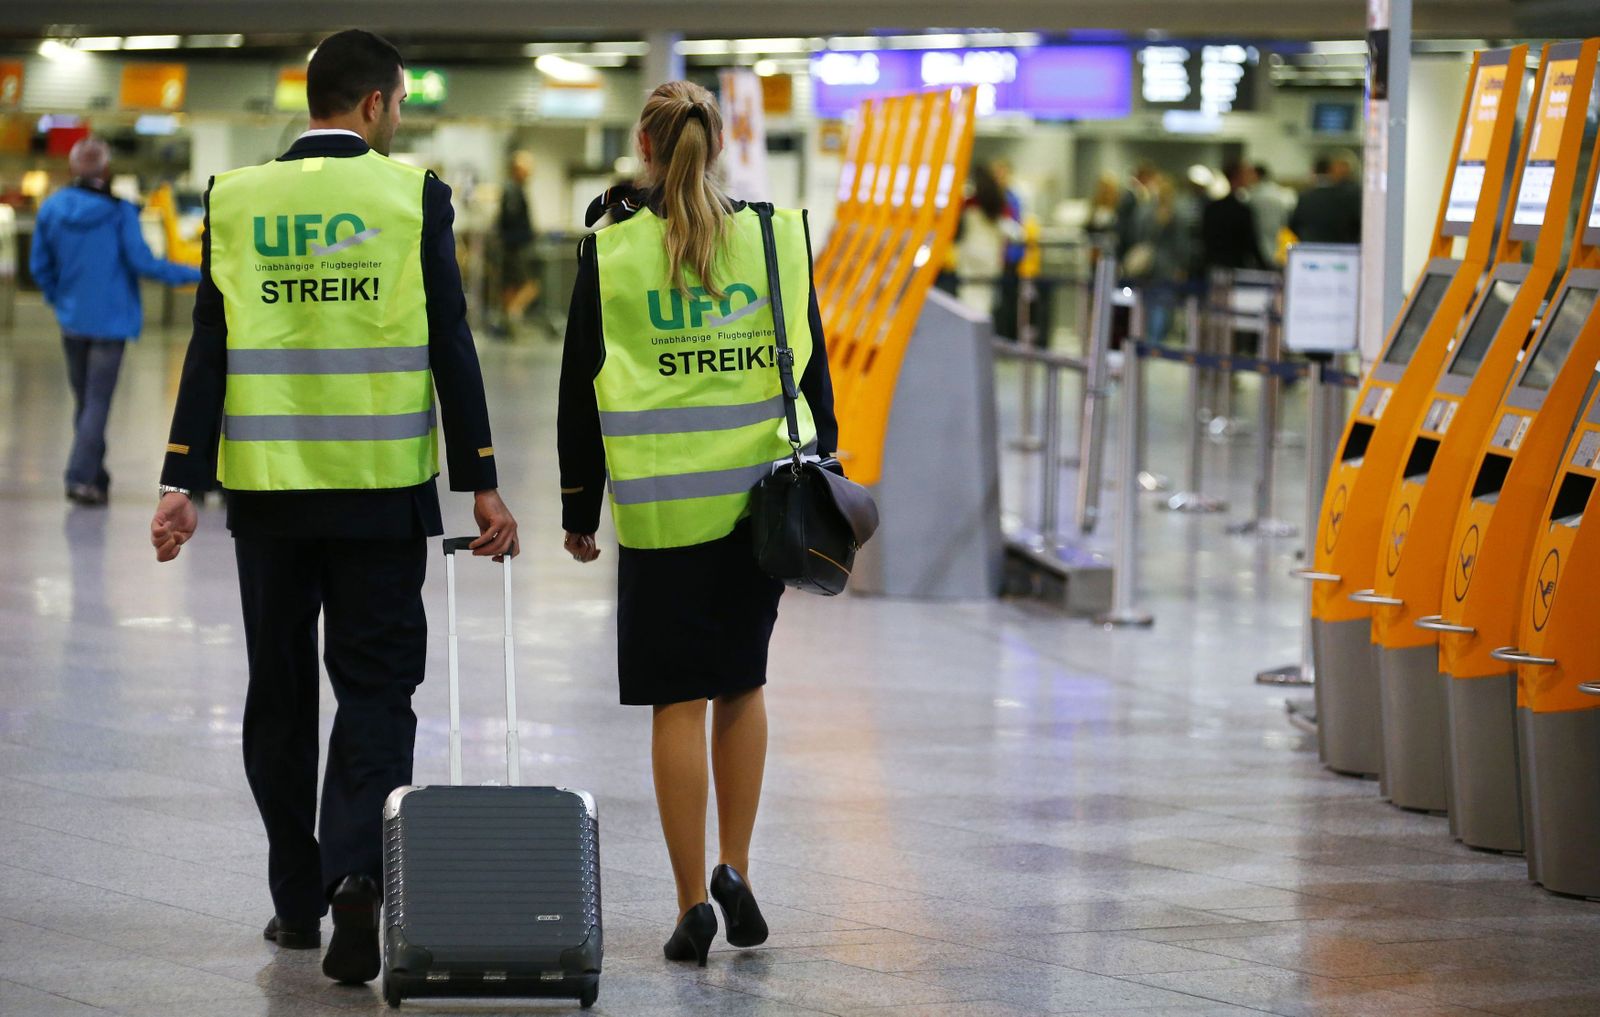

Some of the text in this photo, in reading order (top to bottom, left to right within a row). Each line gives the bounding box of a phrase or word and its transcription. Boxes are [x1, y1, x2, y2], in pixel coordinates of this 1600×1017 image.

[253, 212, 367, 257] UFO
[254, 260, 382, 272] Unabhängige Flugbegleiter
[261, 277, 380, 304] STREIK!
[647, 283, 758, 330] UFO
[651, 329, 777, 346] Unabhängige Flugbegleiter
[658, 345, 775, 377] STREIK!
